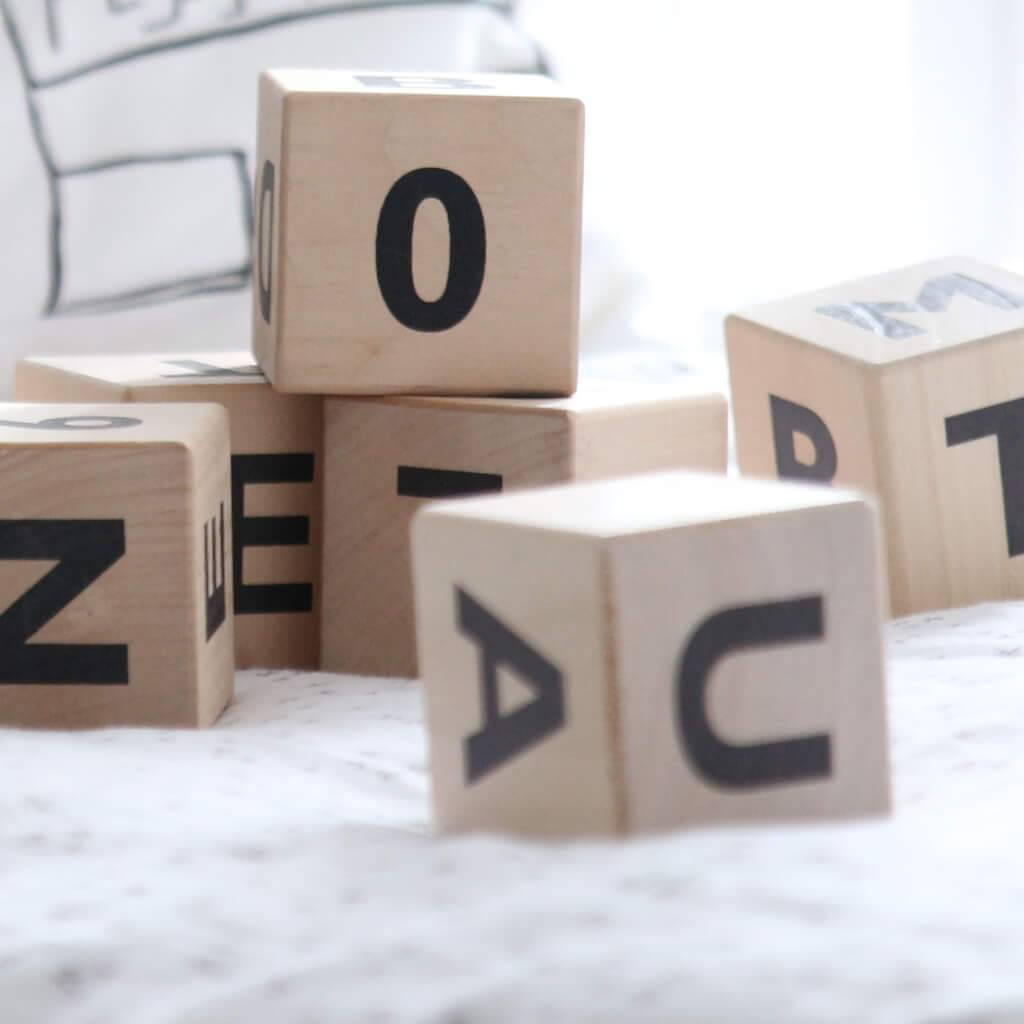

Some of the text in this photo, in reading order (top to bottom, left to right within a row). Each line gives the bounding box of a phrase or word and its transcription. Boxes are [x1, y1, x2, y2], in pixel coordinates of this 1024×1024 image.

[231, 452, 315, 616] E
[944, 396, 1024, 558] T
[204, 499, 226, 644] E
[453, 584, 566, 787] A
[673, 594, 833, 794] U
